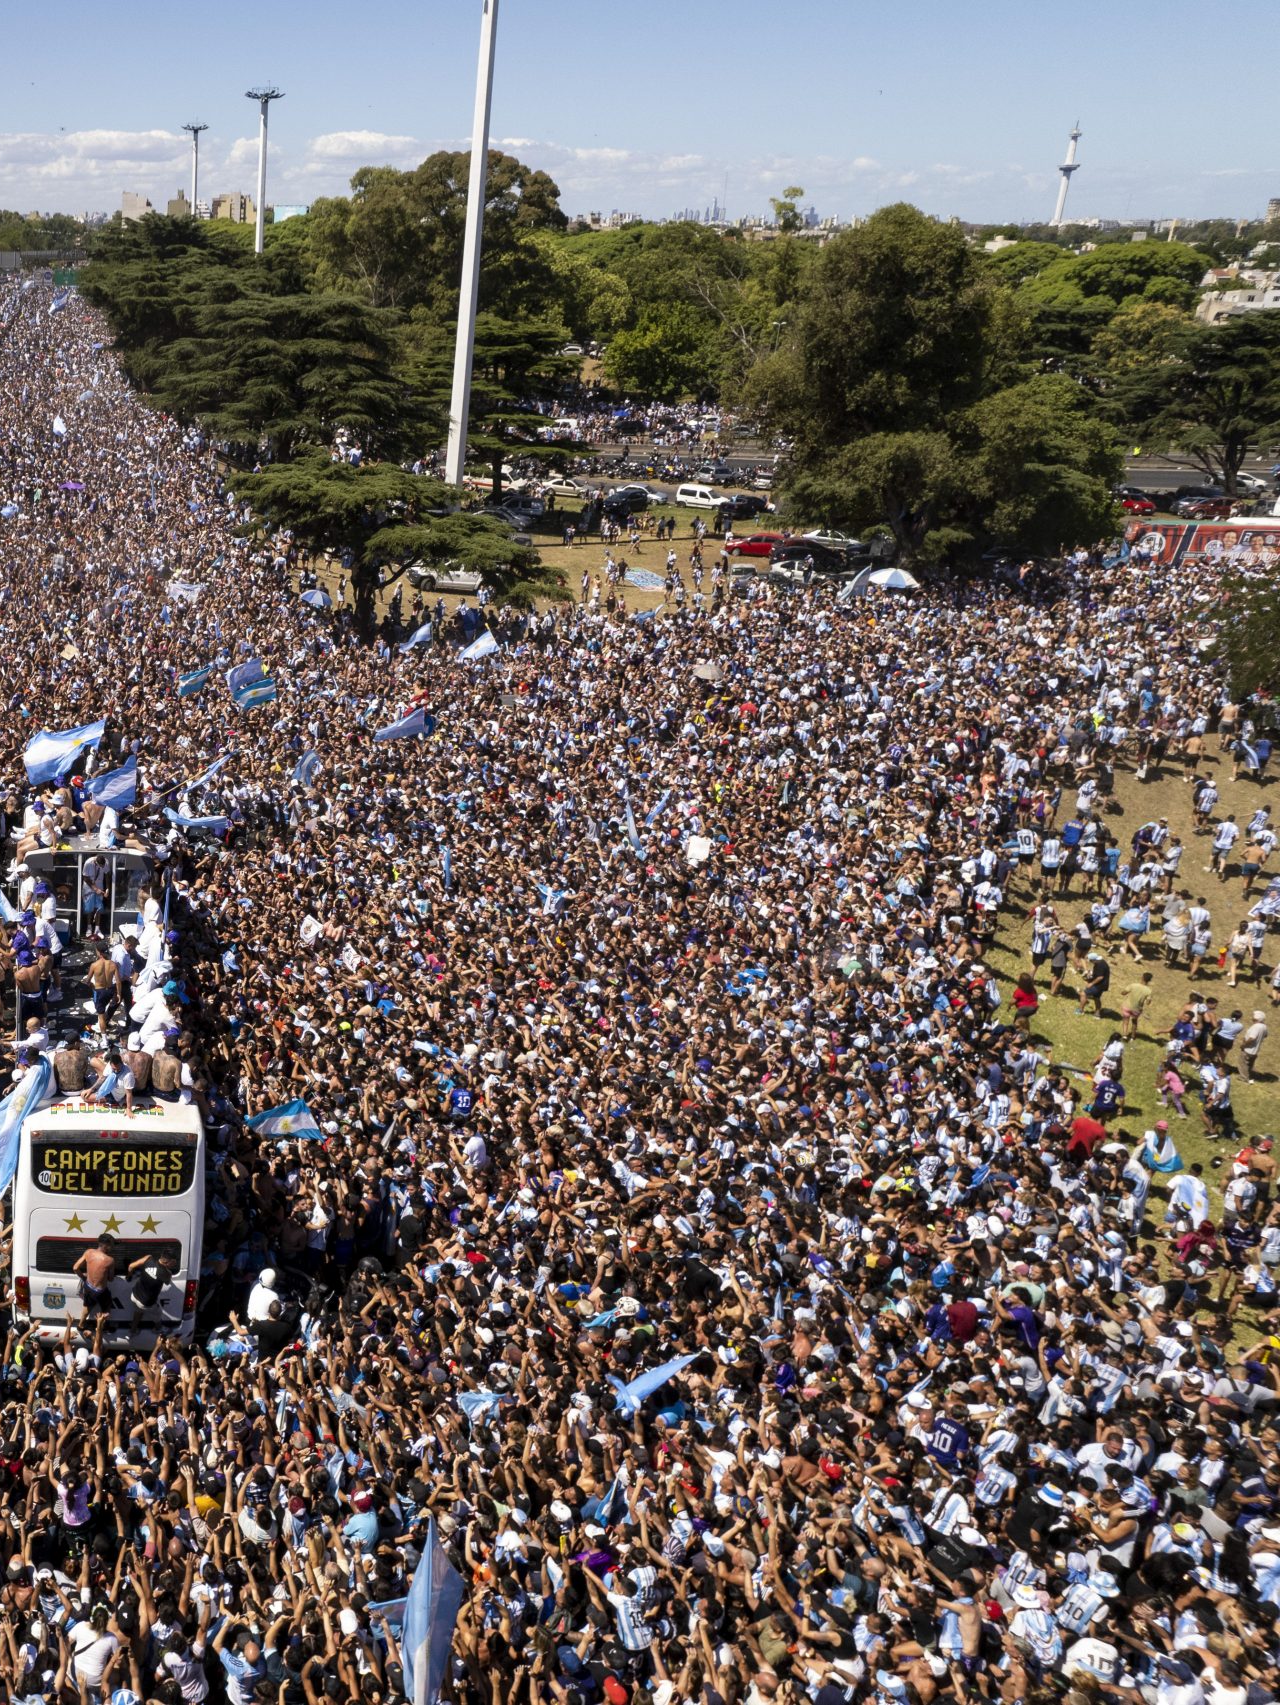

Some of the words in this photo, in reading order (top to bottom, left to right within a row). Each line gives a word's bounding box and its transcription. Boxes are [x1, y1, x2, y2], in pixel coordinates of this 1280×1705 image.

[1019, 835, 1032, 846] 10
[1103, 1092, 1113, 1104] 9
[44, 1149, 183, 1171] CAMPEONES
[49, 1171, 93, 1191] DEL
[103, 1173, 181, 1192] MUNDO
[932, 1429, 952, 1453] 10
[983, 1479, 1002, 1496] 10
[1009, 1566, 1027, 1584] 10
[1065, 1602, 1084, 1621] 10
